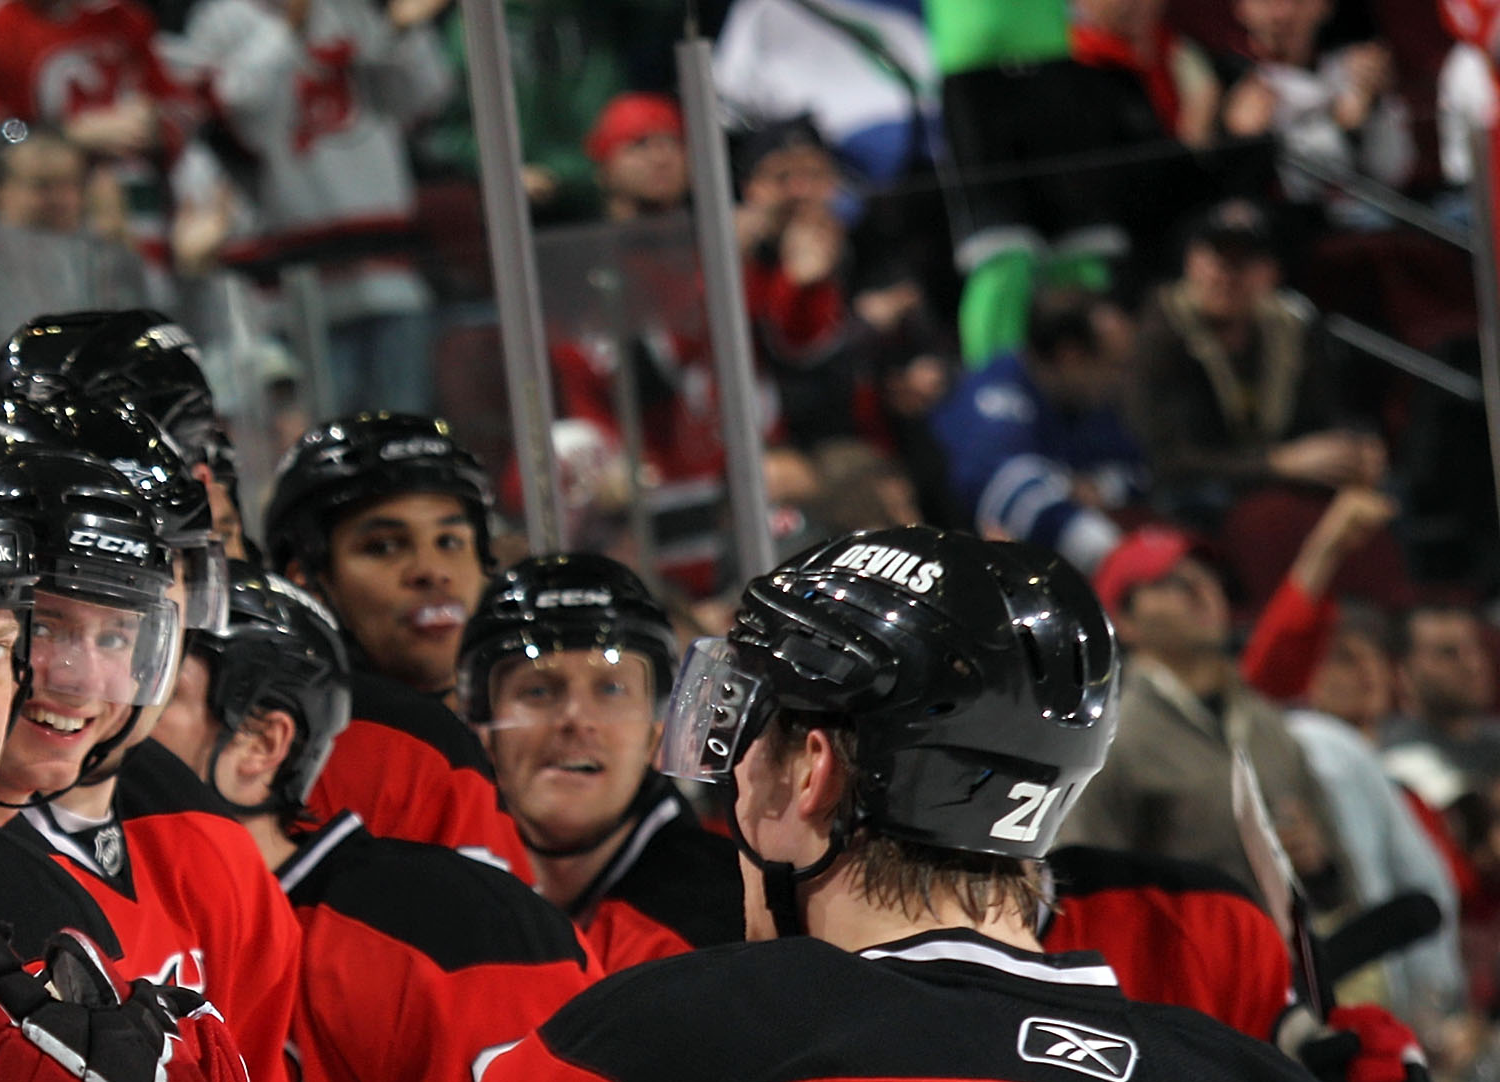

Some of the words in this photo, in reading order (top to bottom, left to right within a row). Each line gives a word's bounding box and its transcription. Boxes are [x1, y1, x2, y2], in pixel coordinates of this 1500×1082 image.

[69, 531, 146, 559] CCM
[832, 544, 944, 594] DEVILS
[989, 781, 1062, 842] 21
